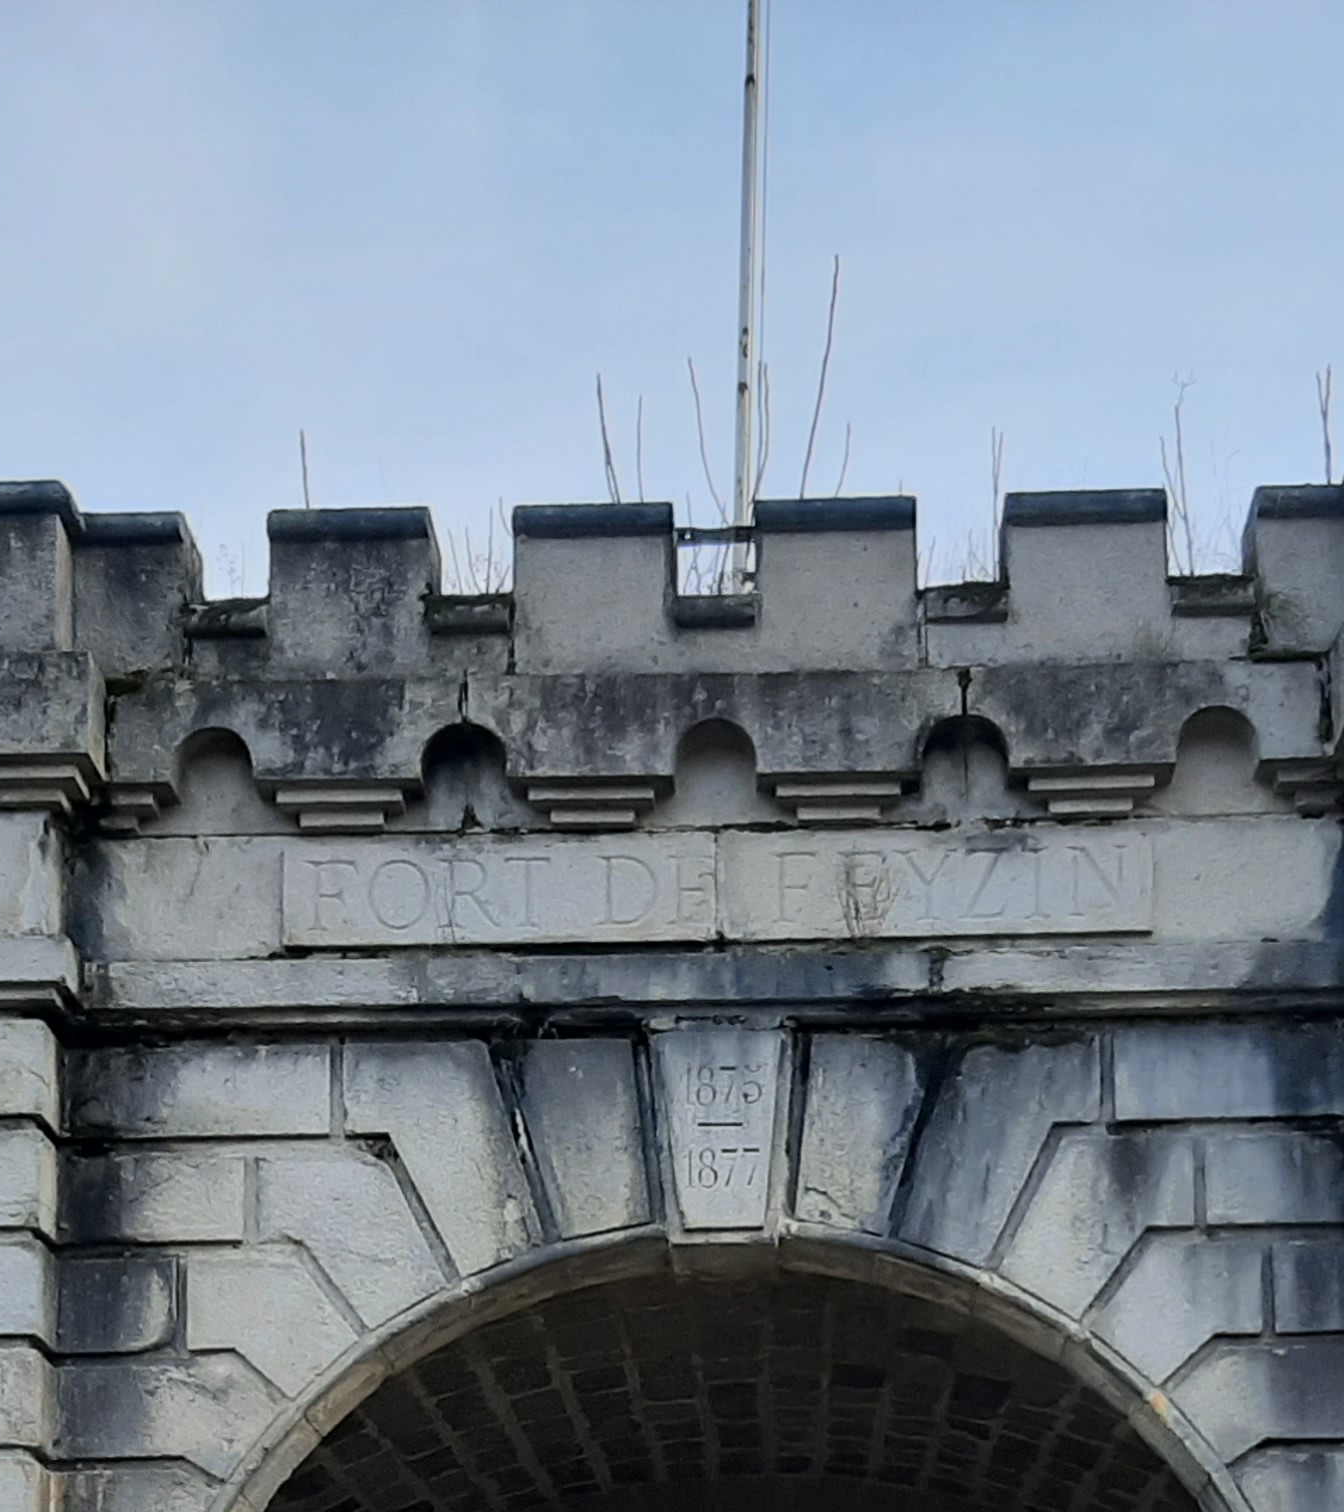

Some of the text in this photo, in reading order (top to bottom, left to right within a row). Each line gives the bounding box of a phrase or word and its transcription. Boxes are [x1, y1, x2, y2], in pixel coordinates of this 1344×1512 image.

[303, 845, 1129, 931] FORT DE FEYZIN
[685, 1062, 768, 1107] 1875
[683, 1144, 760, 1189] 1877
